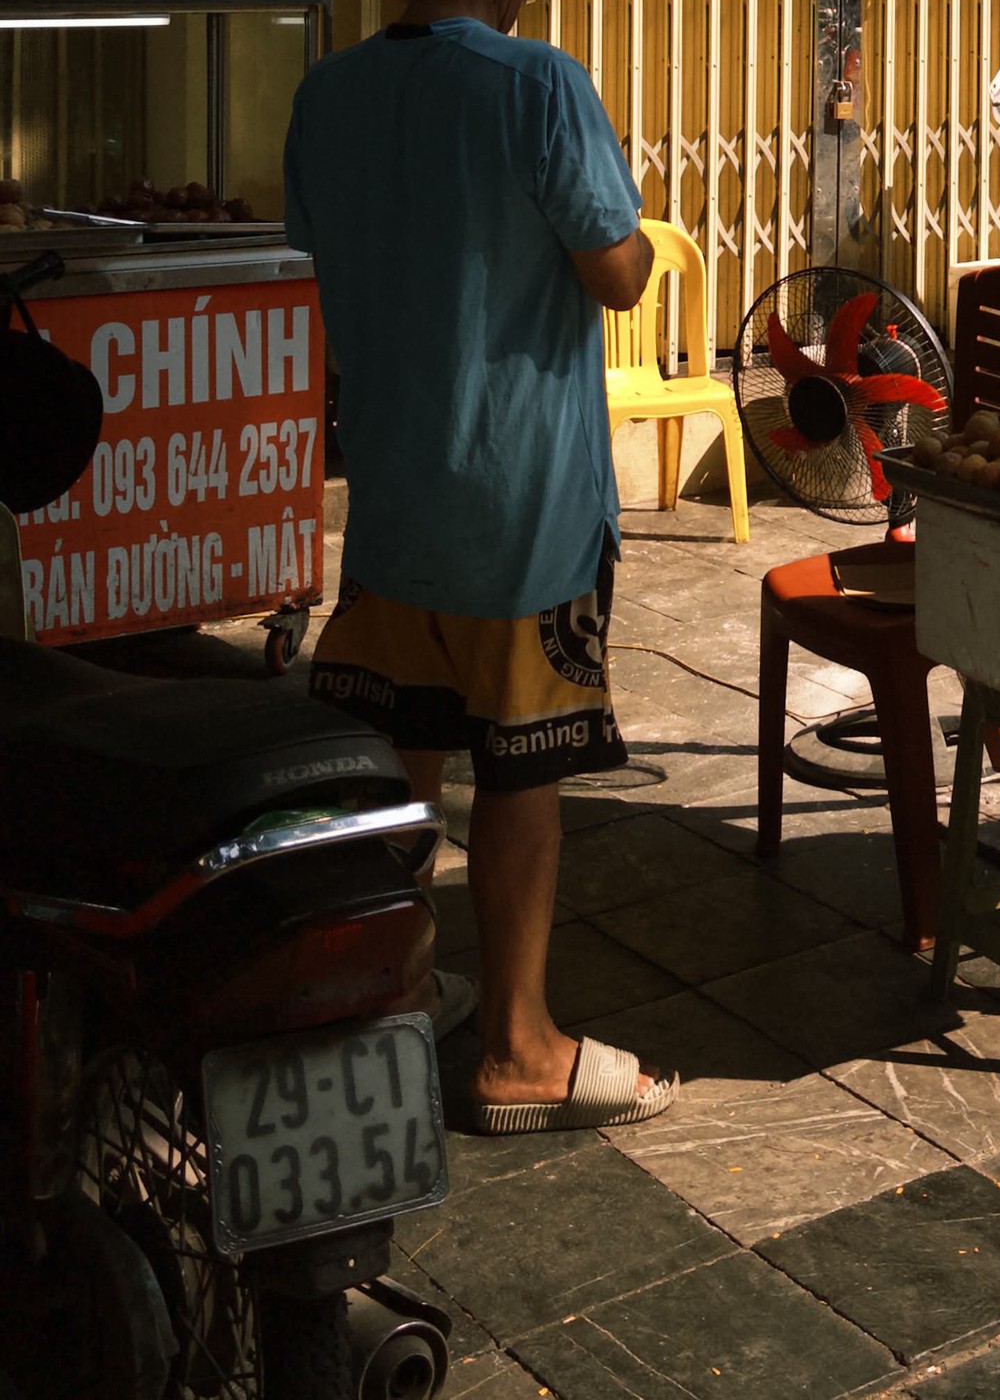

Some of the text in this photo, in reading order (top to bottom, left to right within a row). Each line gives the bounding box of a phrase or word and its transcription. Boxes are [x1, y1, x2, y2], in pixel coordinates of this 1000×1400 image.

[91, 295, 310, 415] CHÍNH
[93, 436, 156, 517] 093
[167, 429, 229, 507] 644
[239, 417, 317, 497] 2537
[106, 520, 223, 621] ĐƯỜNG
[263, 755, 378, 785] HONDA
[247, 1033, 403, 1139] 29-C1
